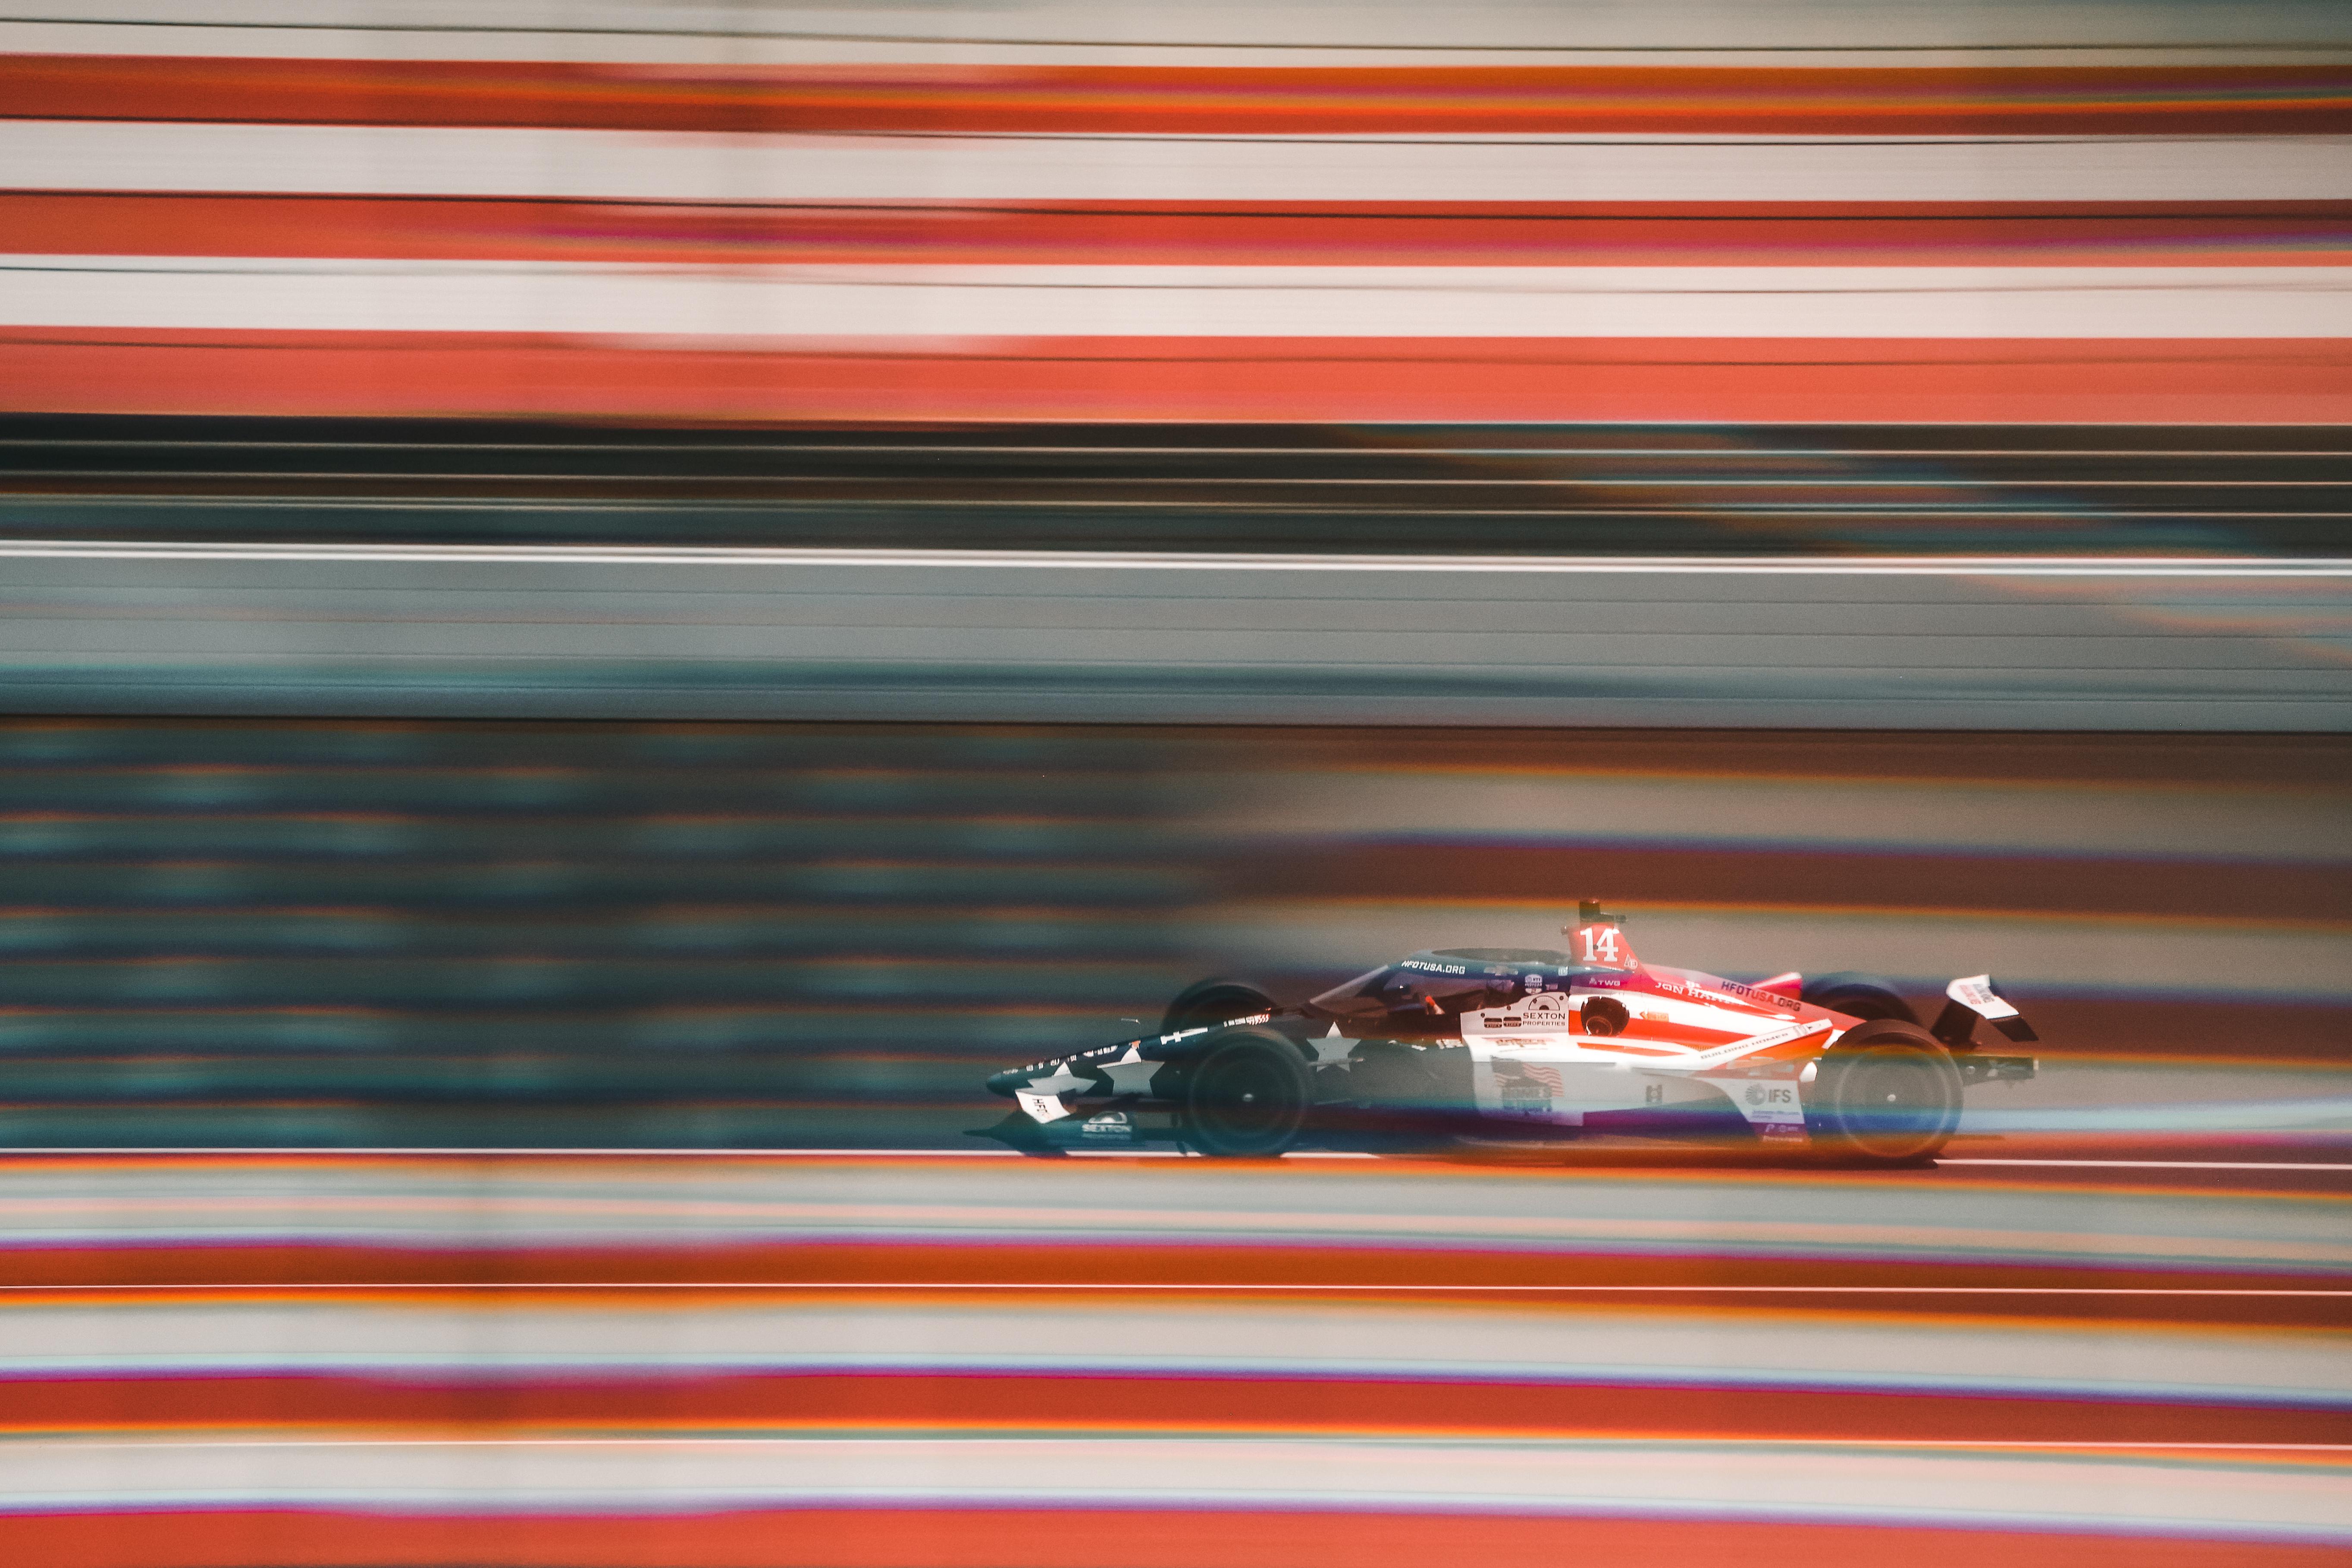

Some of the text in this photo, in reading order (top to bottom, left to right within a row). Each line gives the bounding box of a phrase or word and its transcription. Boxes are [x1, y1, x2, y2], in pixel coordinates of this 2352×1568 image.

[1580, 928, 1620, 961] 14
[1401, 960, 1465, 975] HFOTUSA.ORG
[1655, 982, 1684, 994] JON
[1721, 981, 1801, 1011] HFOTUSA.ORG
[1769, 1089, 1791, 1103] IFS
